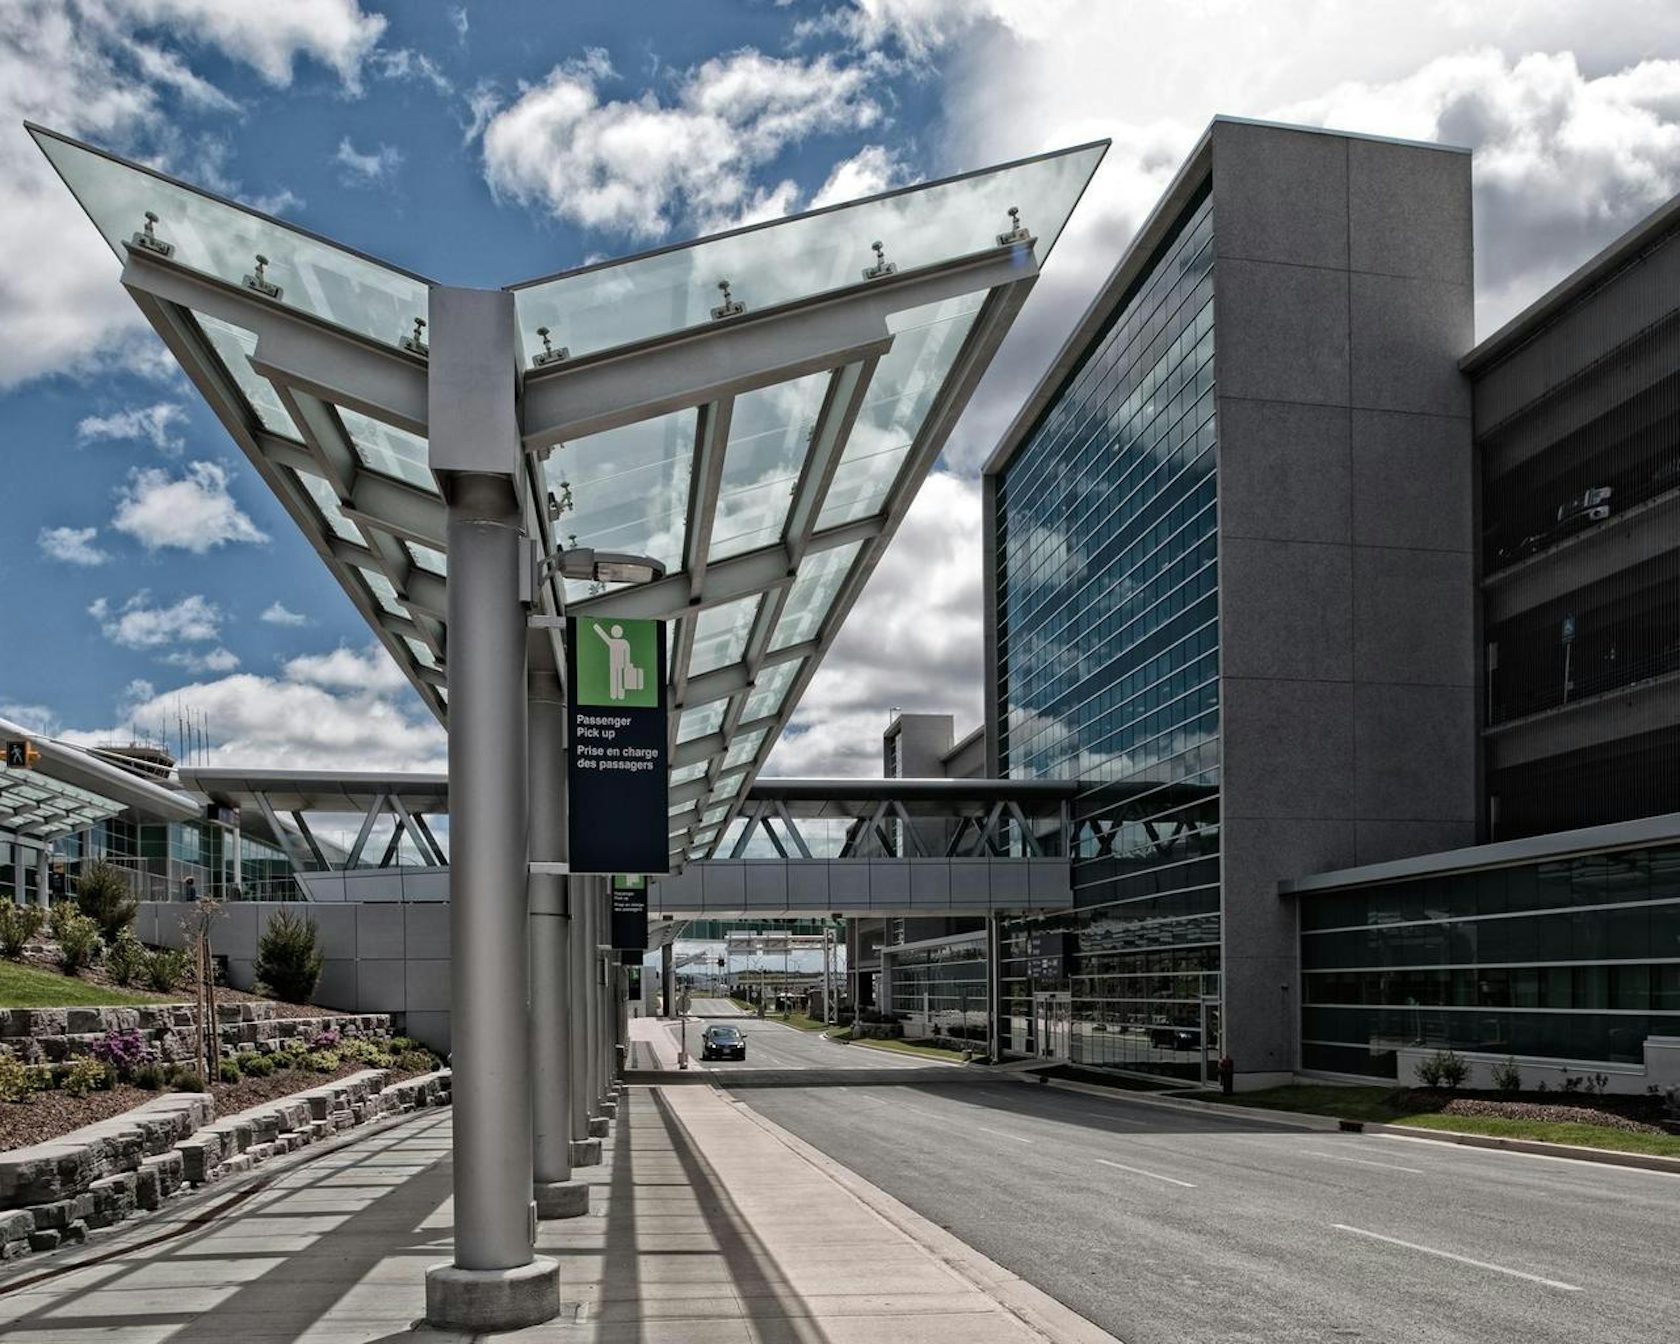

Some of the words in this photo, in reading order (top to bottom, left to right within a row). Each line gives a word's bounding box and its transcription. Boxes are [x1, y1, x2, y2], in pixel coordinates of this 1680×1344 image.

[576, 714, 632, 728] Passenger
[576, 726, 600, 738] Pick
[601, 729, 616, 740] up
[576, 744, 604, 756] Prise
[606, 747, 620, 757] en
[622, 746, 659, 760] charge
[576, 757, 597, 769] des
[599, 760, 654, 772] passagers
